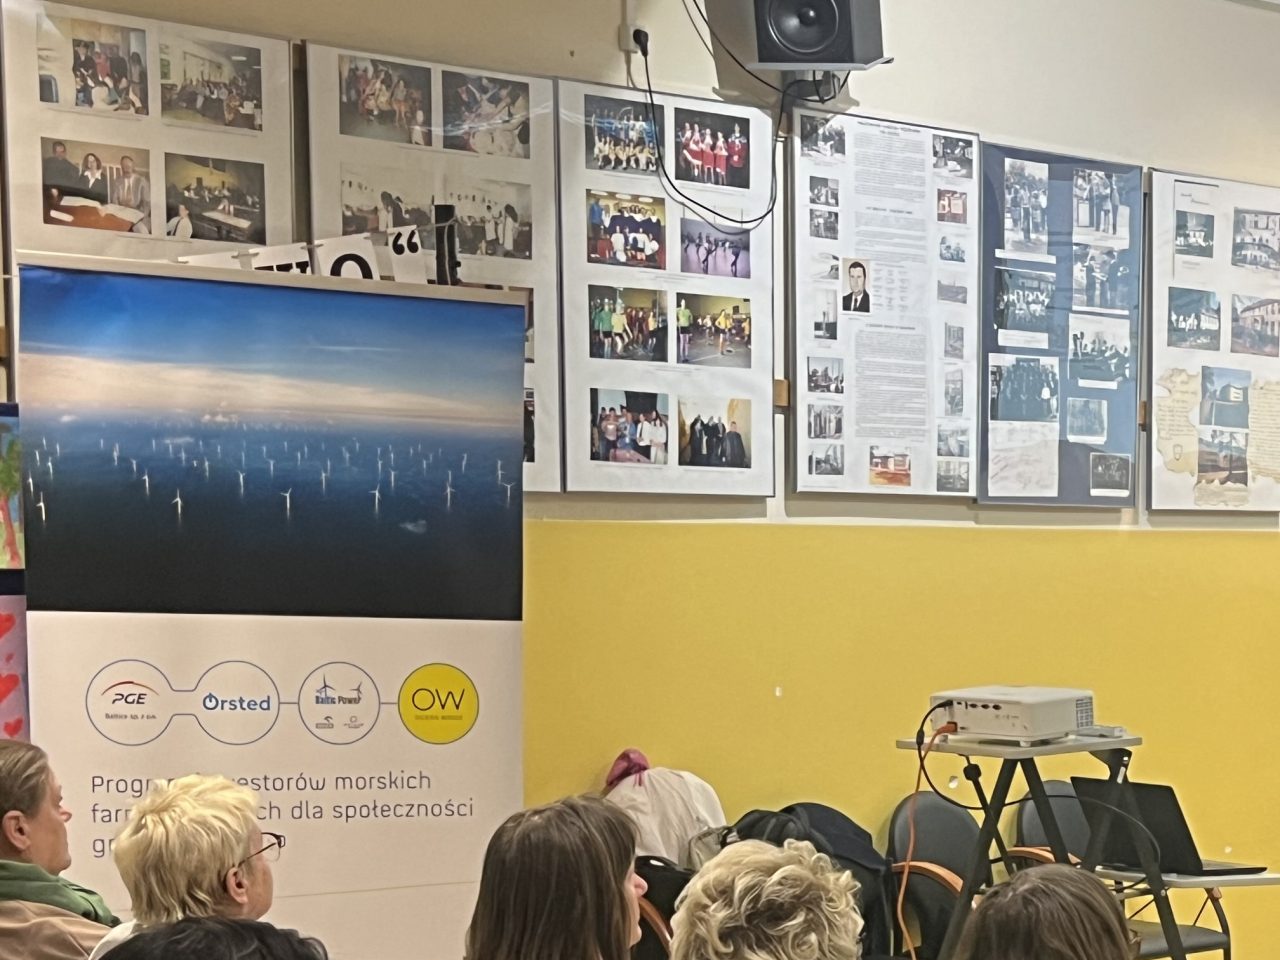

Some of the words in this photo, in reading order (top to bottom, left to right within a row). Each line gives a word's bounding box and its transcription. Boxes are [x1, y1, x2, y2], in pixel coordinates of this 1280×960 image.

[111, 693, 148, 705] PGE
[337, 695, 362, 705] Power
[411, 688, 465, 711] OW
[232, 772, 326, 791] estorów
[335, 770, 431, 791] morskich
[291, 800, 323, 820] dla
[332, 797, 473, 823] społeczności
